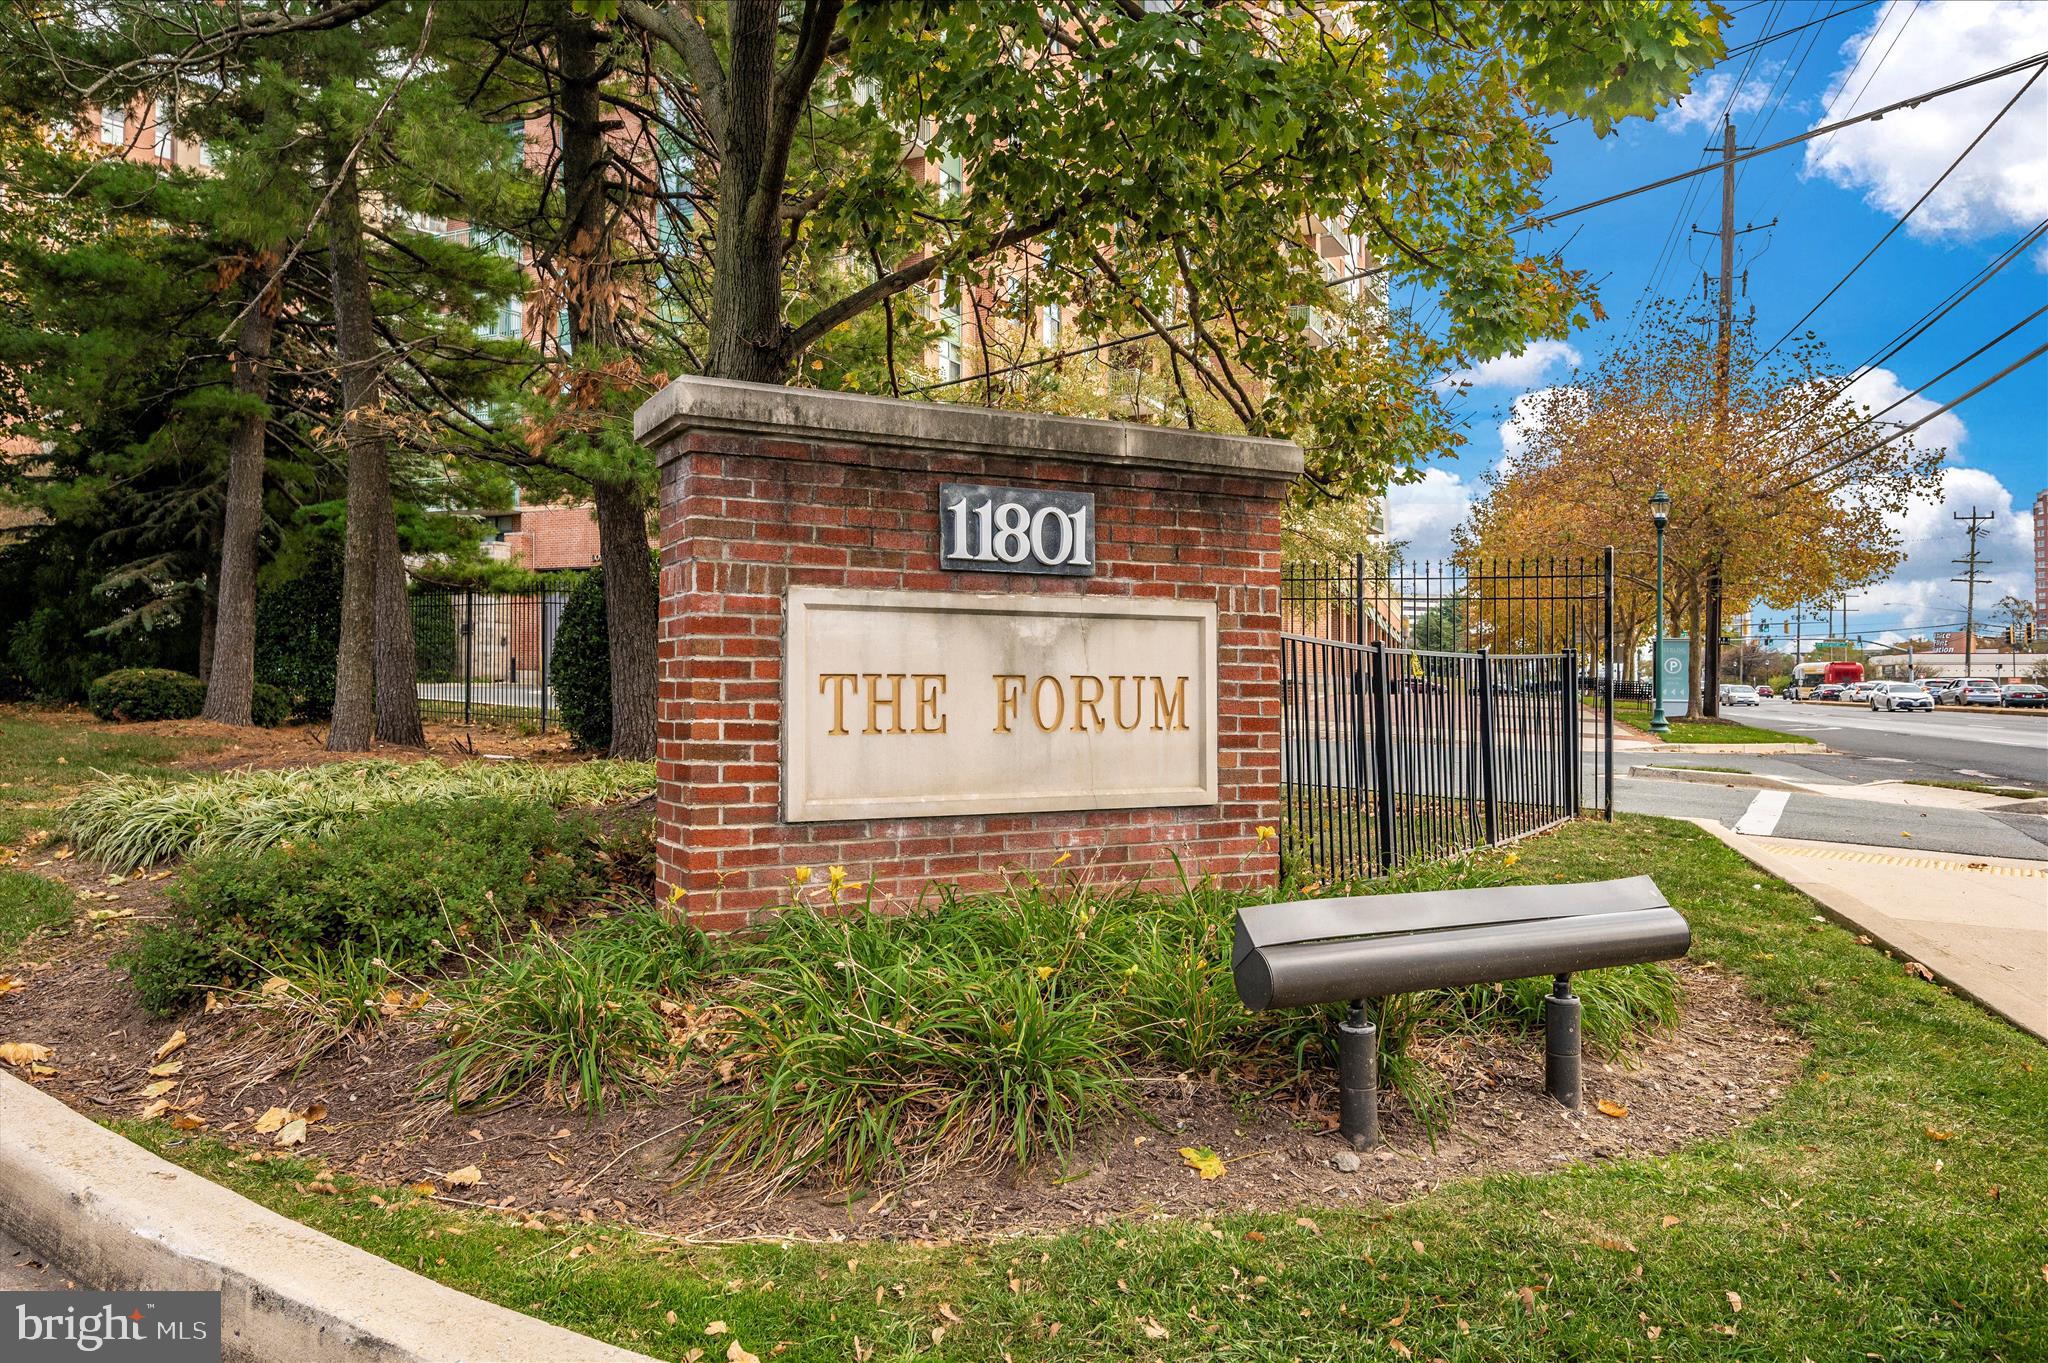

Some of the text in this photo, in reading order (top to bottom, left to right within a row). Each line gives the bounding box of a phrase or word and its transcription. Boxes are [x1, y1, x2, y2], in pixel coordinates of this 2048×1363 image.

[947, 497, 1092, 566] 11801
[819, 673, 1190, 736] THE FORUM
